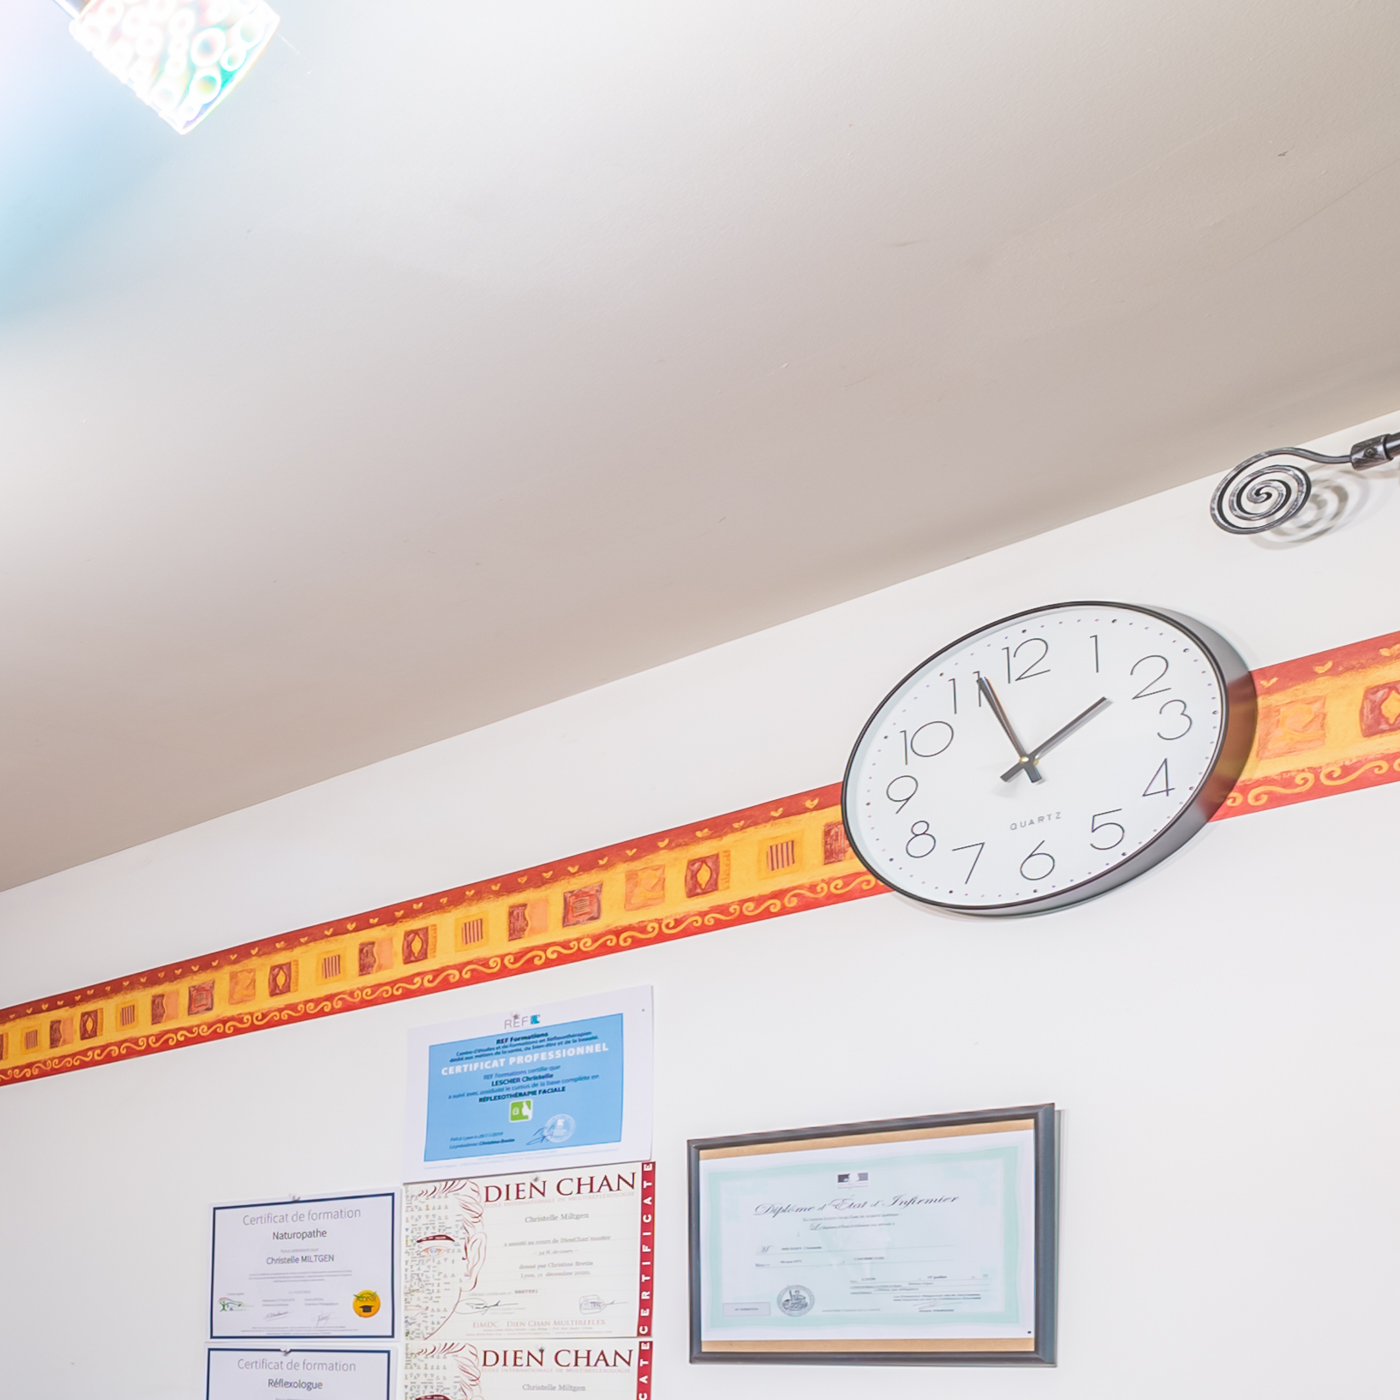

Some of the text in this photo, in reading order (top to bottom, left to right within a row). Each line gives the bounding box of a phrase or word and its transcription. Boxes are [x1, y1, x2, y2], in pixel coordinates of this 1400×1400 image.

[1002, 638, 1050, 683] 12
[1090, 635, 1099, 673] 1
[949, 671, 981, 714] 11
[1130, 654, 1171, 700] 2
[1158, 699, 1192, 740] 3
[900, 721, 954, 765] 10
[886, 775, 918, 814] 9
[1142, 758, 1175, 797] 4
[906, 820, 936, 858] 8
[1010, 812, 1062, 830] QUARTZ
[1090, 808, 1125, 850] 5
[952, 842, 986, 884] 7
[1020, 840, 1055, 880] 6
[441, 1043, 609, 1075] CERTIFICAT PROFESSIONNEL
[485, 1172, 637, 1203] DIEN CHAN
[243, 1208, 361, 1226] Certificat de formation
[273, 1229, 327, 1240] Naturopathe
[640, 1163, 653, 1334] CERTIFICATE
[238, 1359, 356, 1372] Certificat de formation
[482, 1350, 633, 1367] DIEN CHAN
[268, 1379, 323, 1391] Réflexologue
